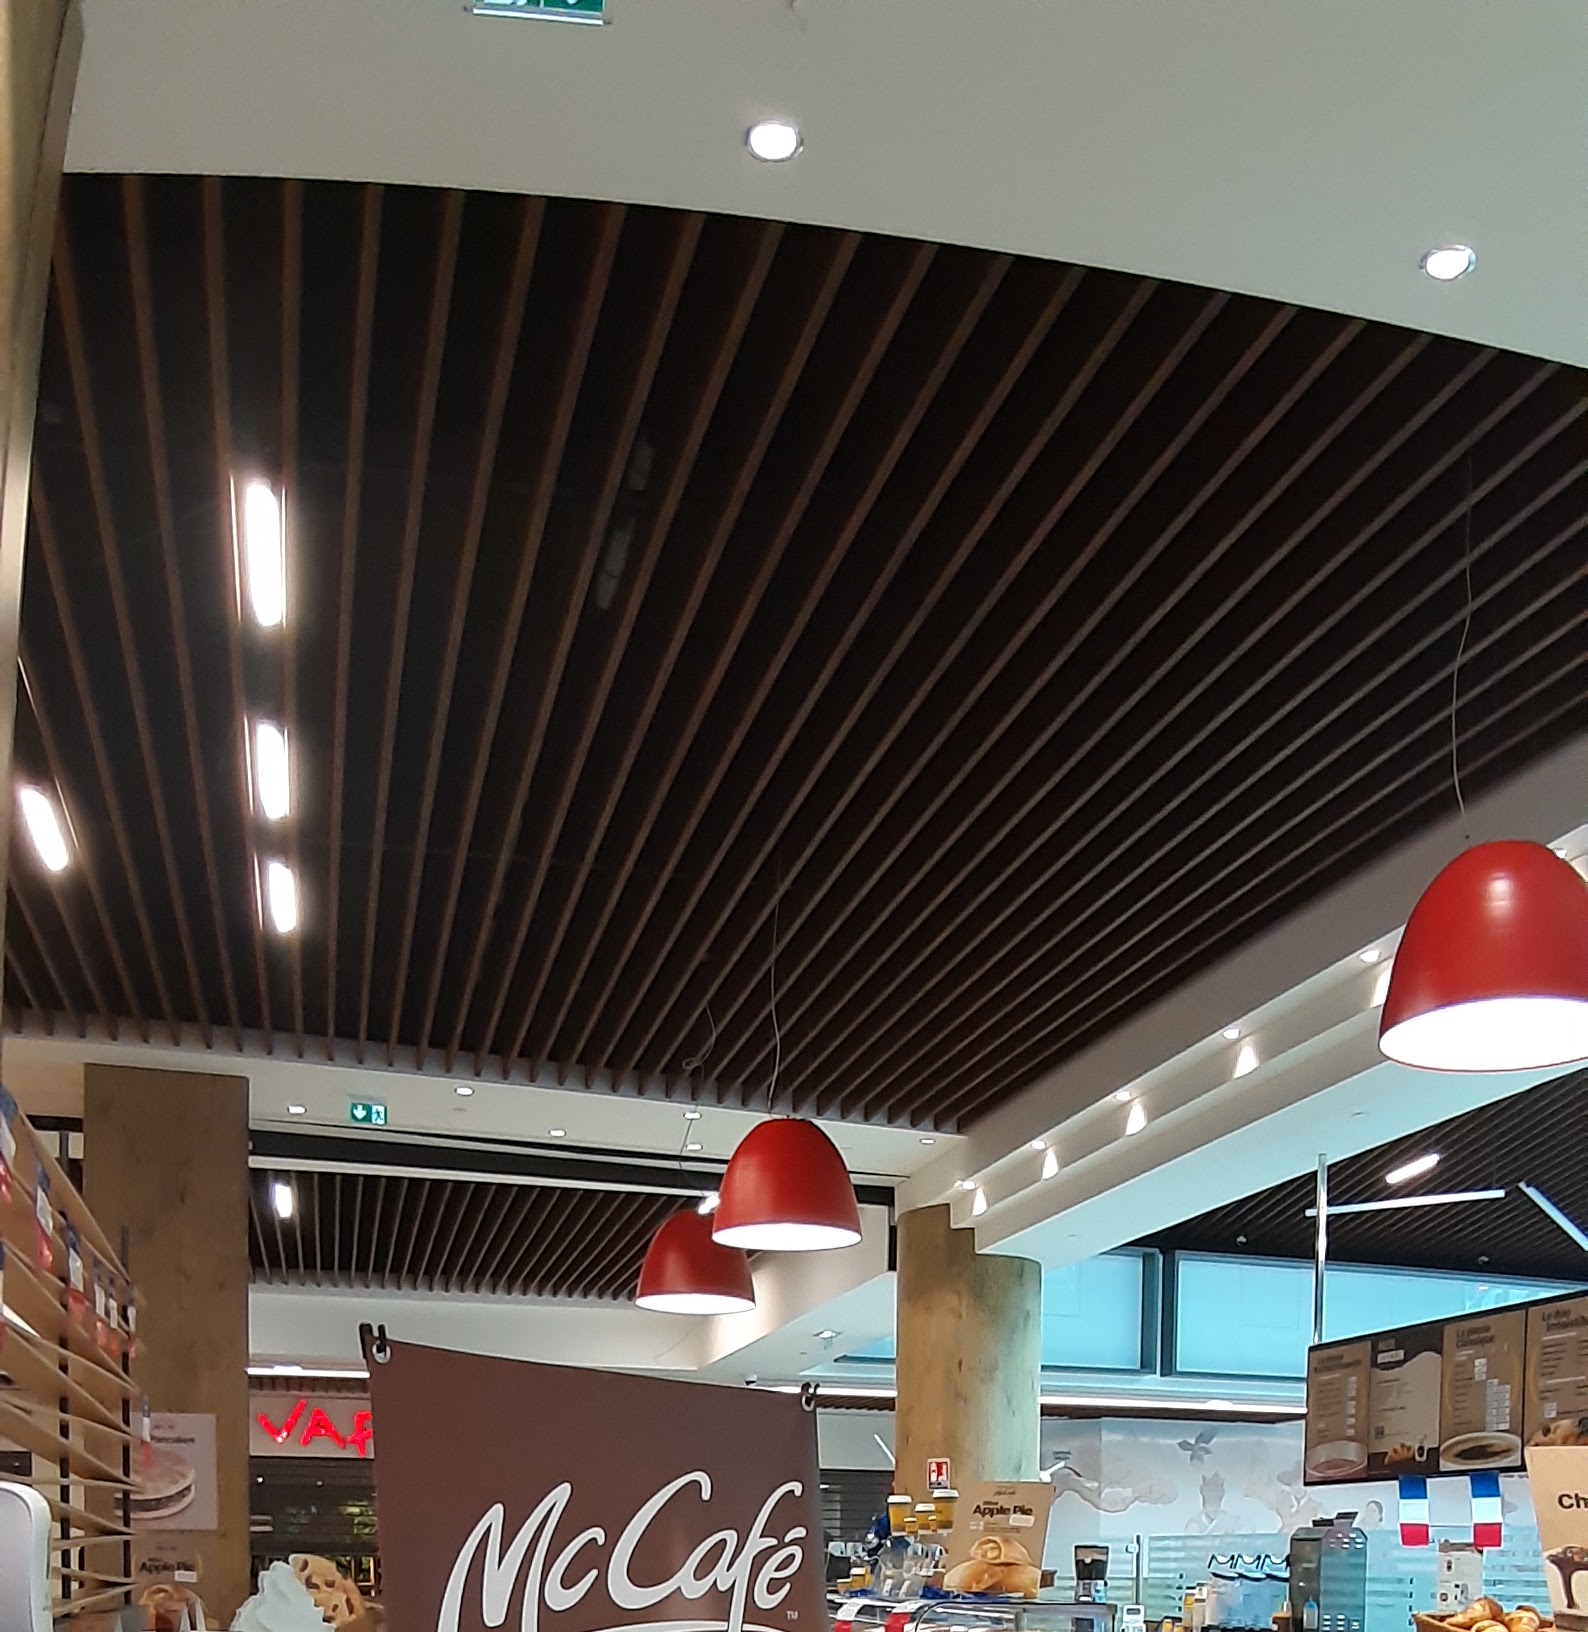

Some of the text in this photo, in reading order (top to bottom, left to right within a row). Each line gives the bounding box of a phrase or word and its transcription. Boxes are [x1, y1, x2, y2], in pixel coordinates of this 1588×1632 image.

[973, 1504, 1033, 1518] Apple Pie
[139, 1562, 175, 1575] Apple
